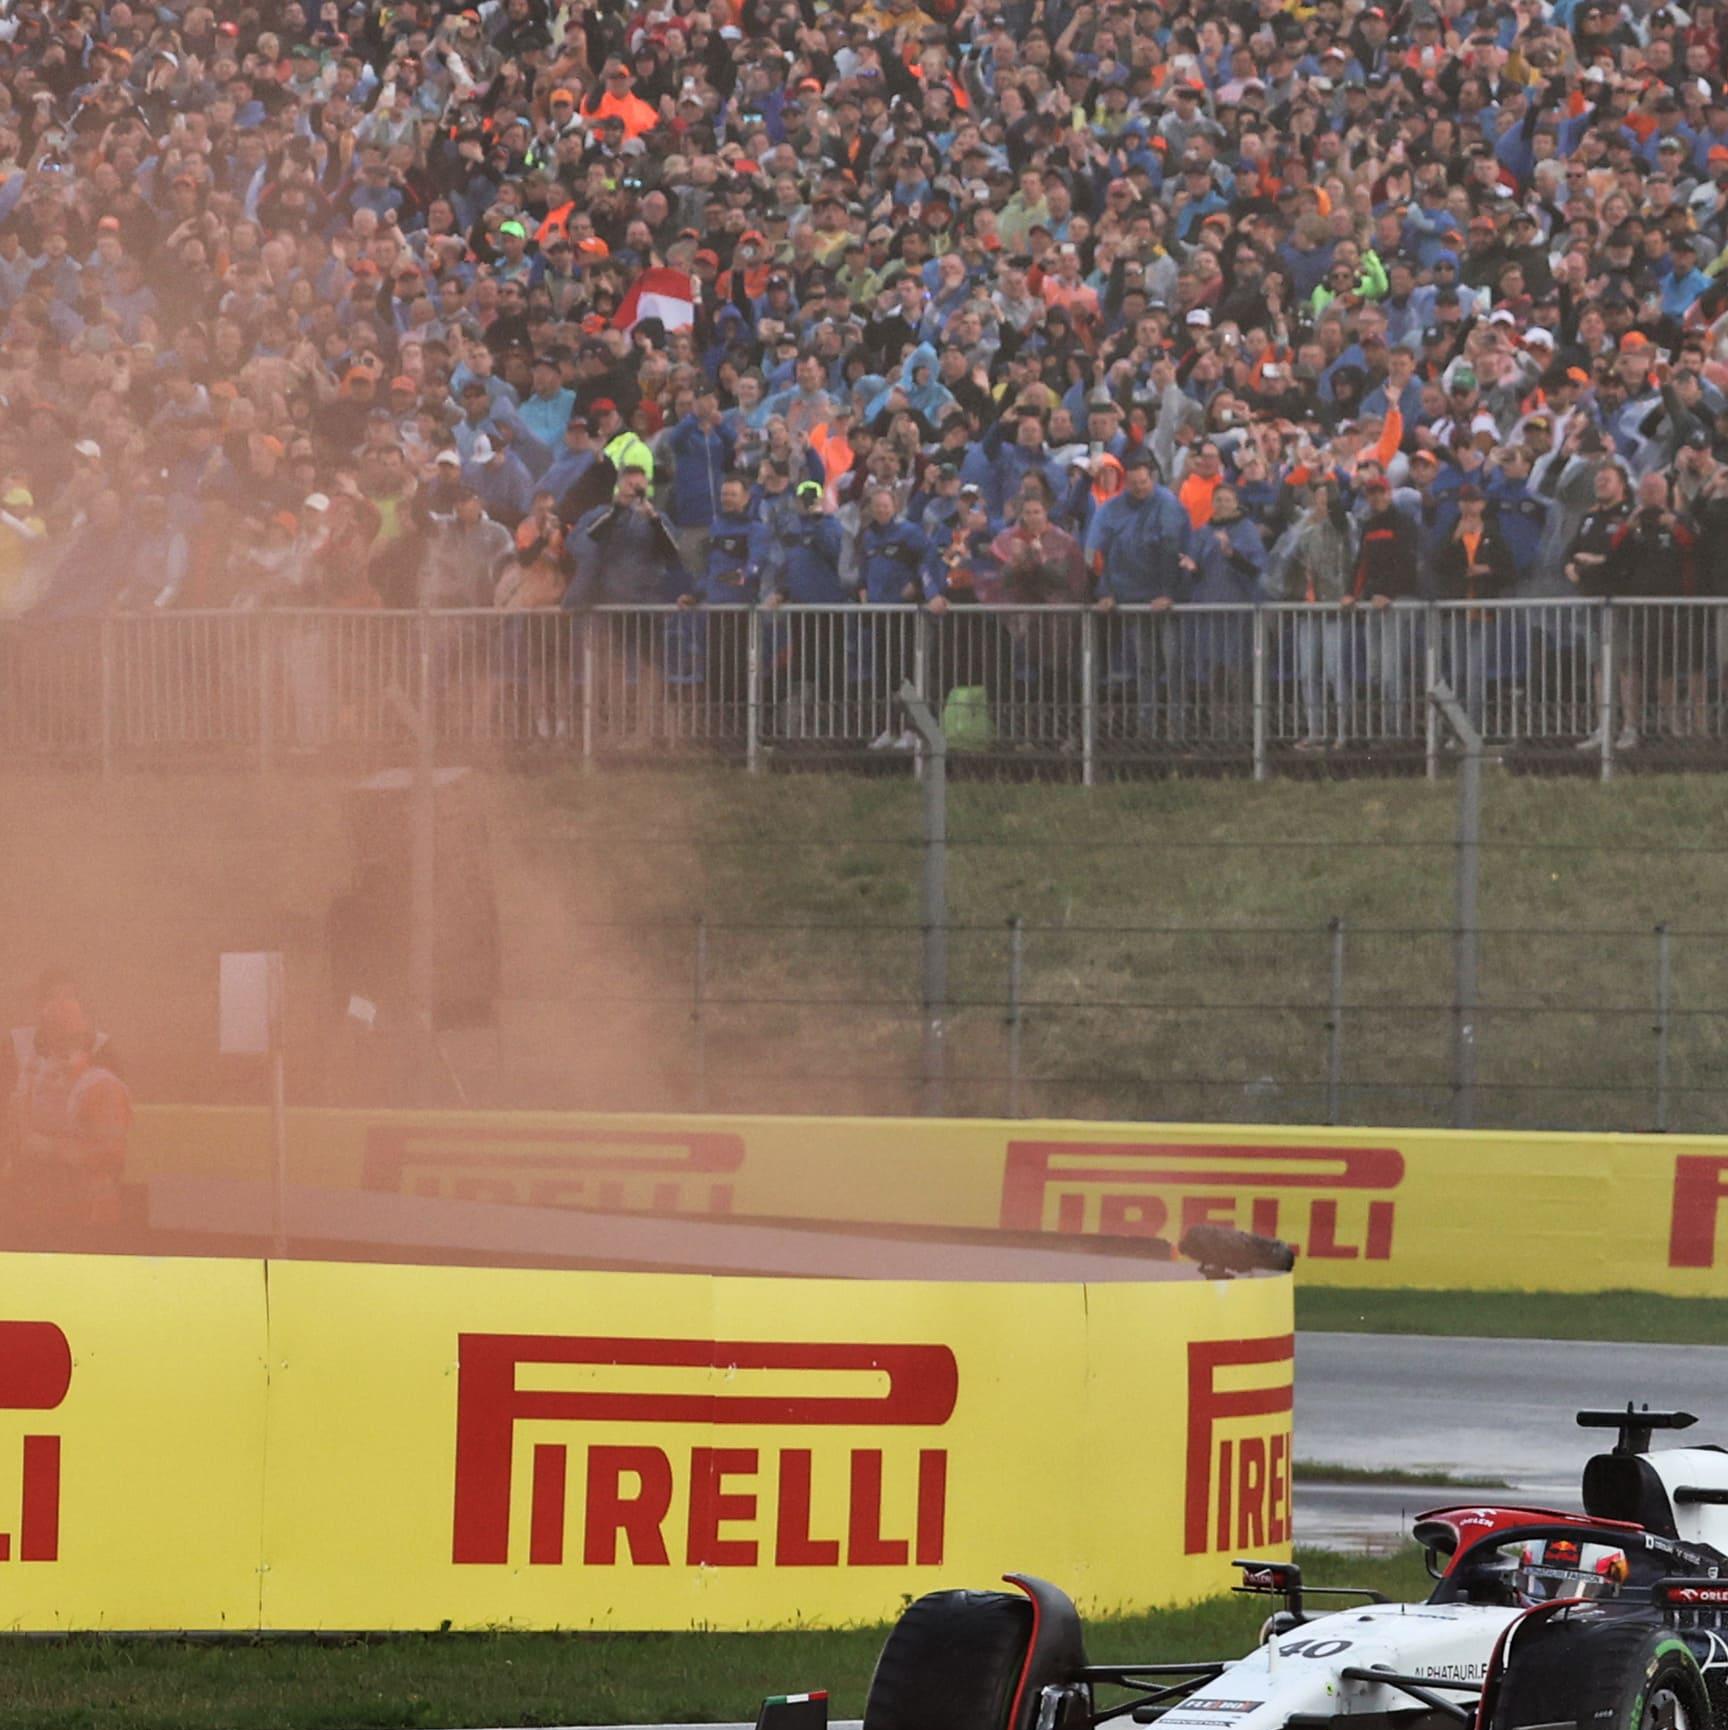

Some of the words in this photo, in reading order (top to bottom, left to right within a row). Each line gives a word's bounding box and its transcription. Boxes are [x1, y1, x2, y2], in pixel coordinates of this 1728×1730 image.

[1001, 1140, 1405, 1260] PIRELLI
[452, 1332, 958, 1566] PIRELLI
[1184, 1334, 1294, 1556] PIREL
[1279, 1639, 1353, 1659] 40
